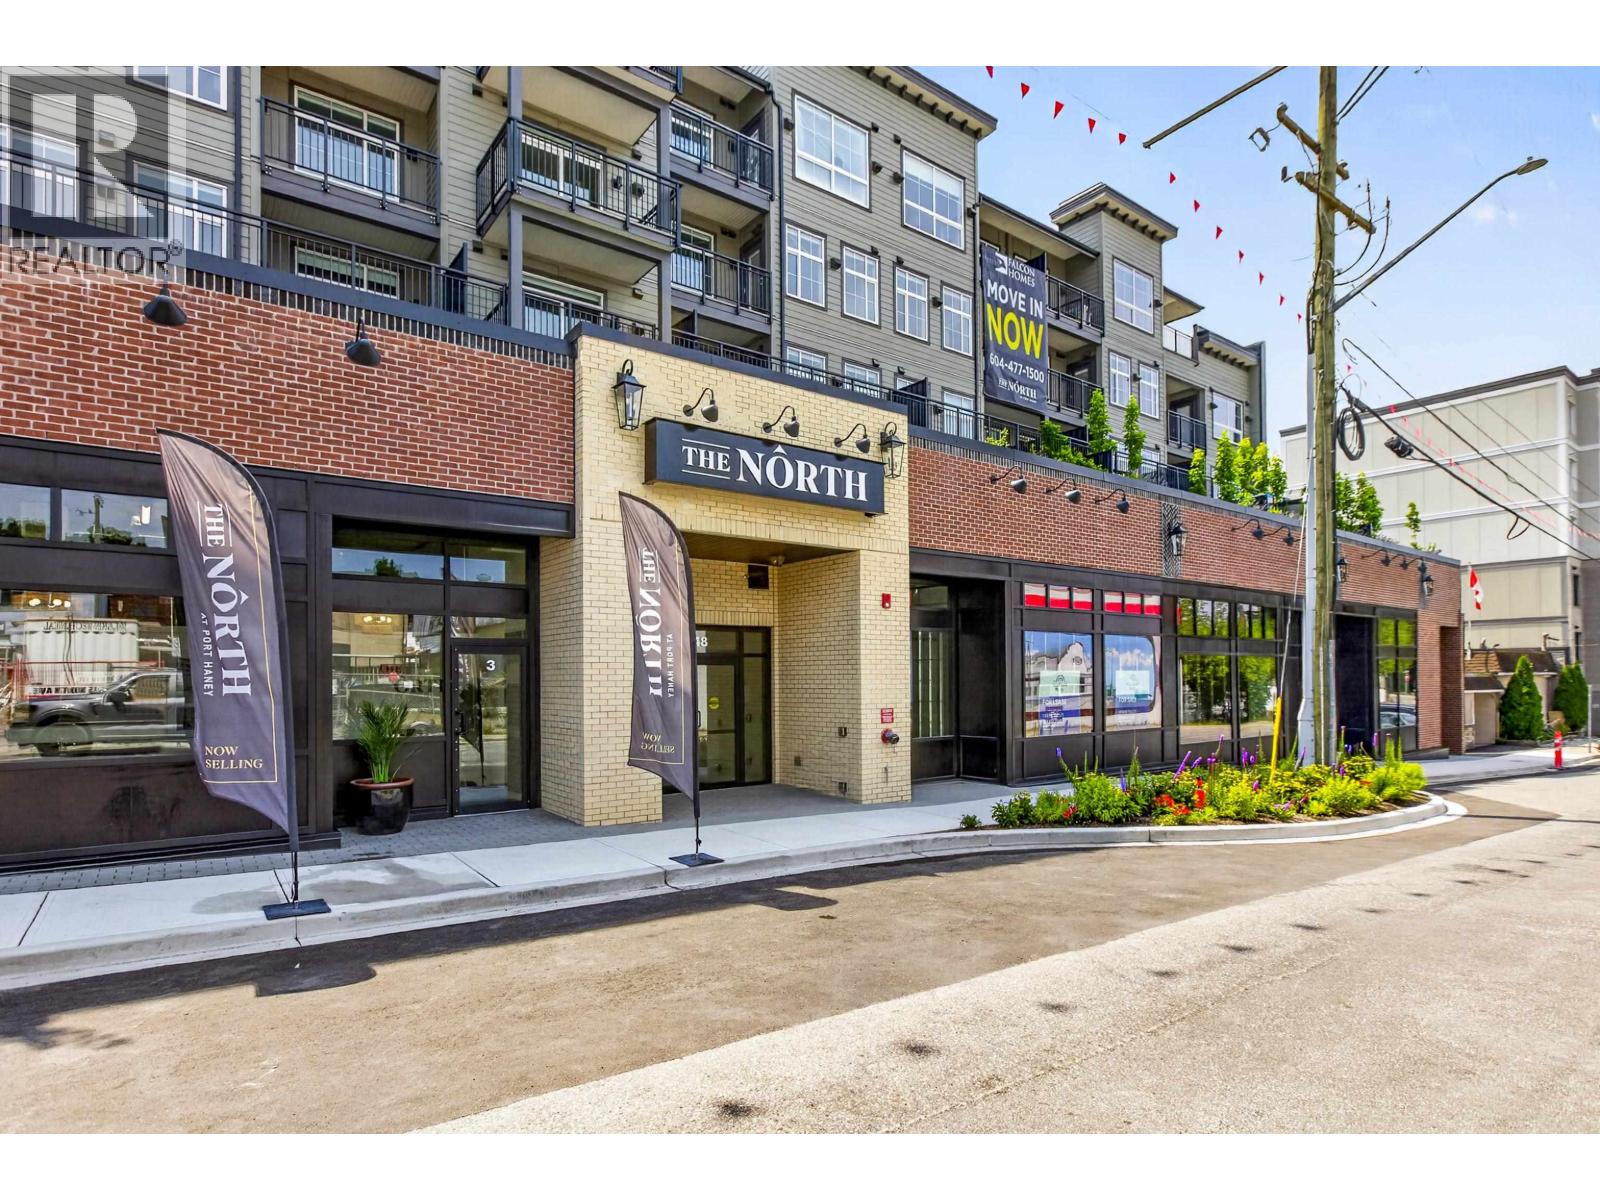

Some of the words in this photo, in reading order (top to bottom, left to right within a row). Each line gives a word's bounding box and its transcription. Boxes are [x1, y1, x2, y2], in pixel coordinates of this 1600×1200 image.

[1008, 257, 1035, 277] FALCON
[1008, 269, 1035, 287] HOMES
[987, 279, 1026, 313] MOVE
[1029, 297, 1043, 319] IN
[987, 303, 1044, 359] NOW
[990, 353, 1045, 383] 604-477-1500
[682, 446, 731, 472] THE
[736, 444, 868, 501] NÔRTH
[203, 503, 225, 547] THE
[200, 612, 208, 625] AT
[202, 552, 251, 696] NÔRTH
[202, 627, 213, 657] PORT
[203, 661, 214, 697] HANEY
[485, 659, 496, 671] 3
[204, 745, 239, 756] NOW
[205, 759, 264, 769] SELLING
